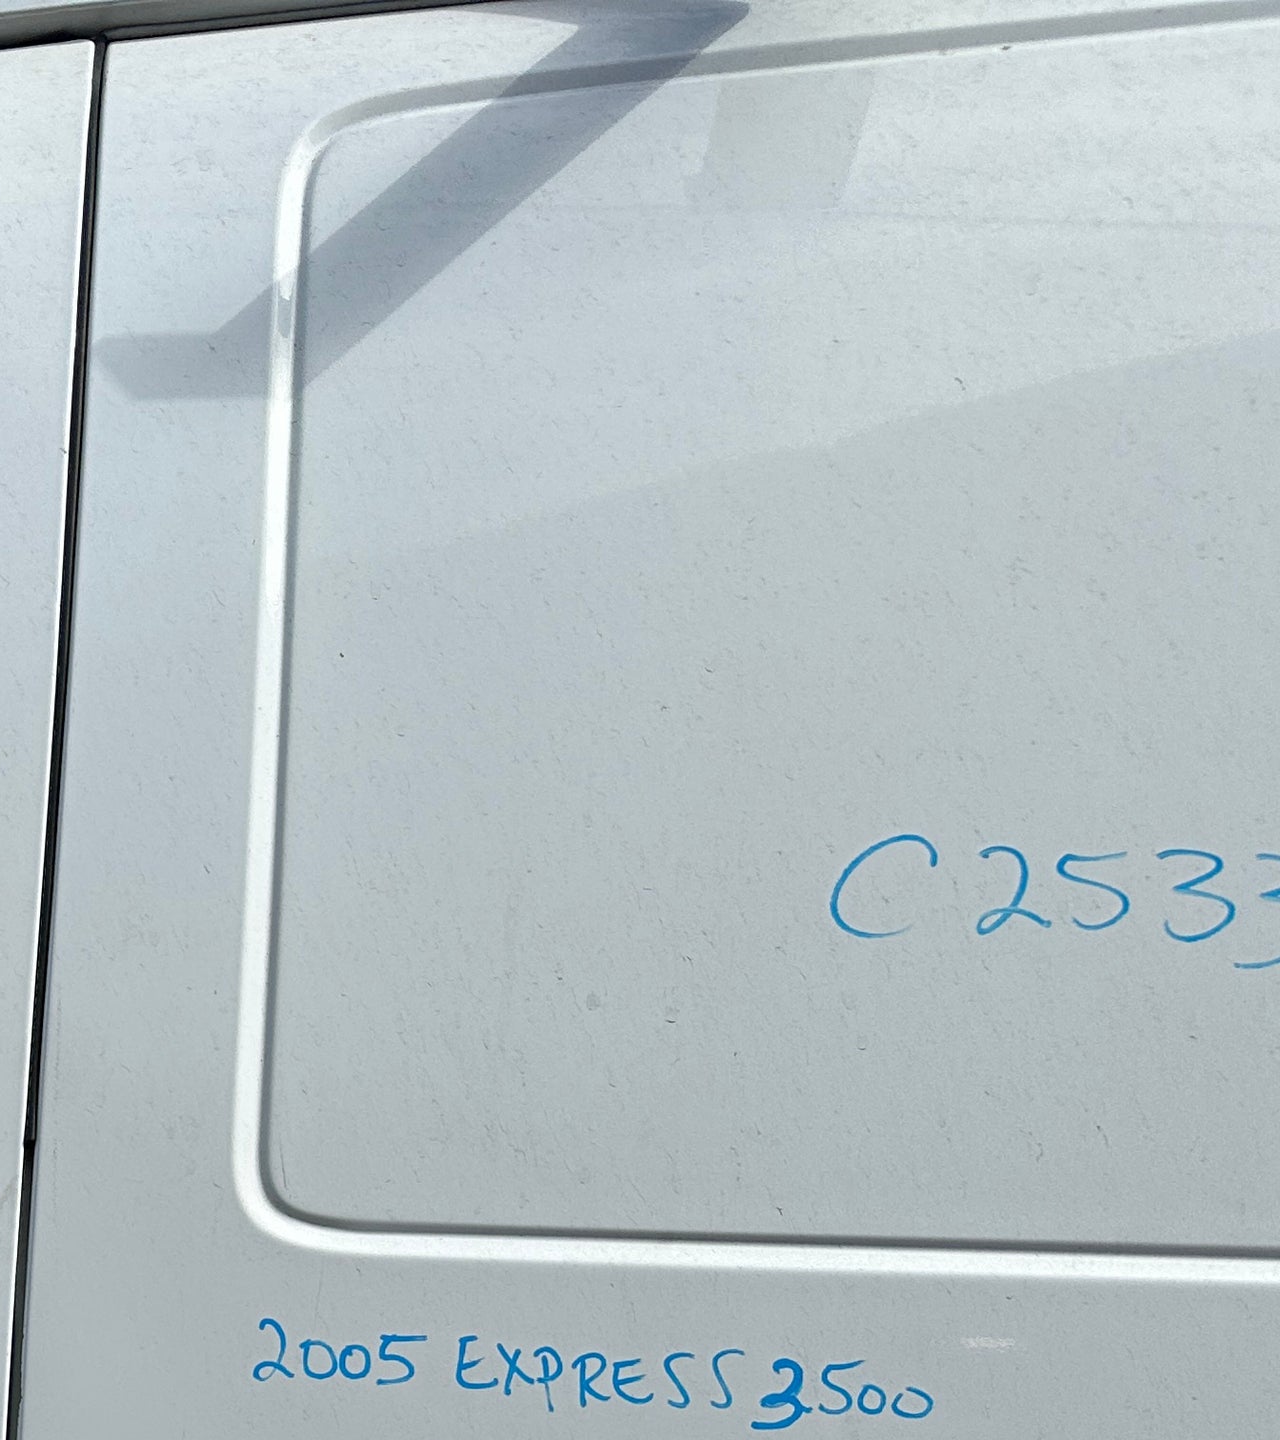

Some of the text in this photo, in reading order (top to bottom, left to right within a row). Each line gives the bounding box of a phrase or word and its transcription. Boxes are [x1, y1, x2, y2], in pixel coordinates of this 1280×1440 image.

[252, 1317, 936, 1431] 2005 EXPRESS 3500
